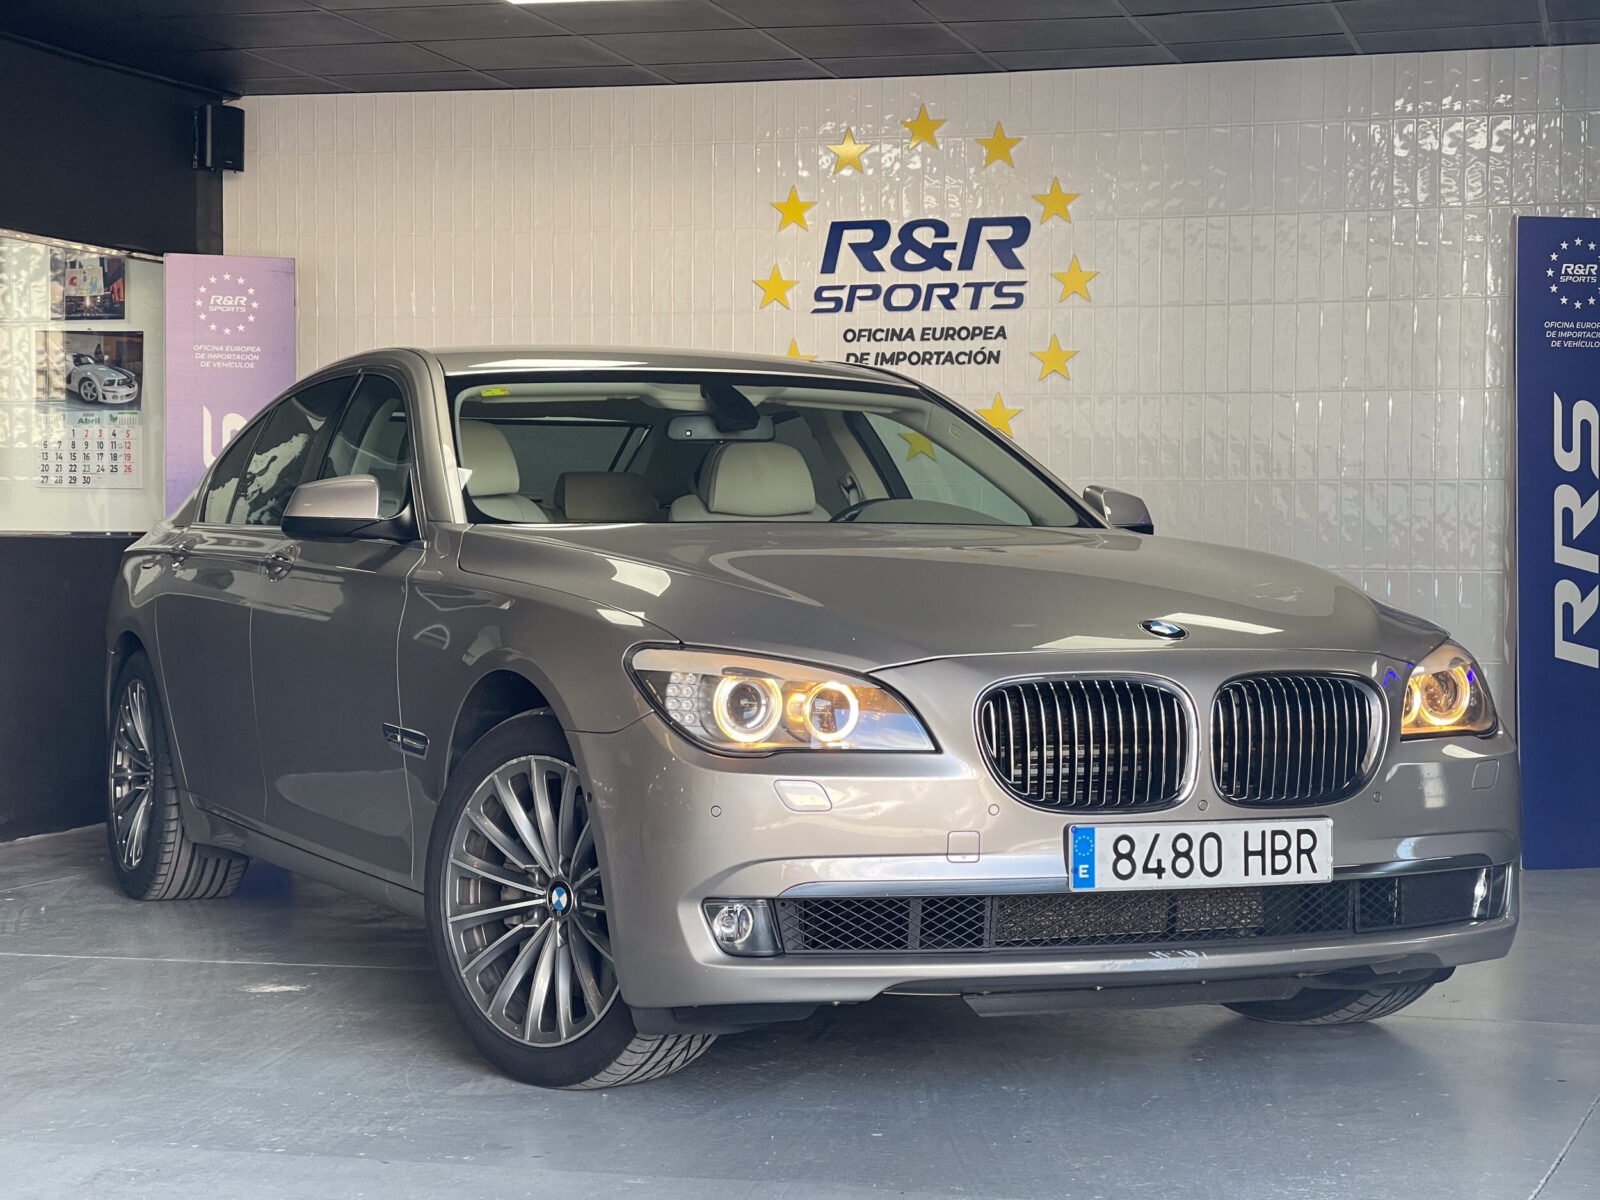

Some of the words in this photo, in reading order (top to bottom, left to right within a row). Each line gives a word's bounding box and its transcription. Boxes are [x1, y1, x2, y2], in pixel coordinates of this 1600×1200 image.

[820, 216, 1031, 274] R&R
[1561, 263, 1598, 275] R&R
[1560, 275, 1597, 283] SPORTS
[209, 295, 247, 306] R&R
[810, 280, 1028, 314] SPORTS
[1544, 321, 1575, 329] OFICINA
[843, 327, 915, 343] OFICINA
[920, 325, 1007, 341] EUROPEA
[193, 344, 224, 352] OFICINA
[1551, 340, 1562, 348] DE
[207, 352, 260, 361] IMPORTACIÓN
[846, 352, 870, 365] DE
[874, 347, 1001, 366] IMPORTACIÓN
[212, 360, 256, 369] VEHÍCULOS
[77, 417, 100, 425] Abril
[72, 429, 75, 437] 1
[84, 429, 89, 437] 2
[98, 429, 103, 437] 3
[111, 429, 117, 437] 4
[125, 429, 130, 437] 5
[71, 441, 76, 449] 8
[84, 441, 89, 449] 9
[96, 441, 104, 449] 10
[110, 441, 117, 449] 11
[124, 441, 131, 449] 12
[41, 452, 49, 461] 13
[55, 452, 63, 461] 14
[69, 452, 77, 461] 15
[83, 452, 90, 461] 16
[96, 452, 104, 461] 17
[110, 452, 118, 461] 18
[124, 452, 131, 461] 19
[40, 464, 49, 473] 20
[55, 464, 62, 473] 21
[68, 464, 77, 473] 22
[83, 464, 91, 473] 23
[96, 464, 105, 473] 24
[110, 464, 118, 473] 25
[123, 464, 132, 473] 26
[40, 476, 49, 485] 27
[54, 476, 63, 485] 28
[68, 476, 77, 485] 29
[82, 476, 91, 485] 30
[1078, 864, 1090, 878] E
[1112, 831, 1223, 881] 8480
[1243, 828, 1318, 877] HBR
